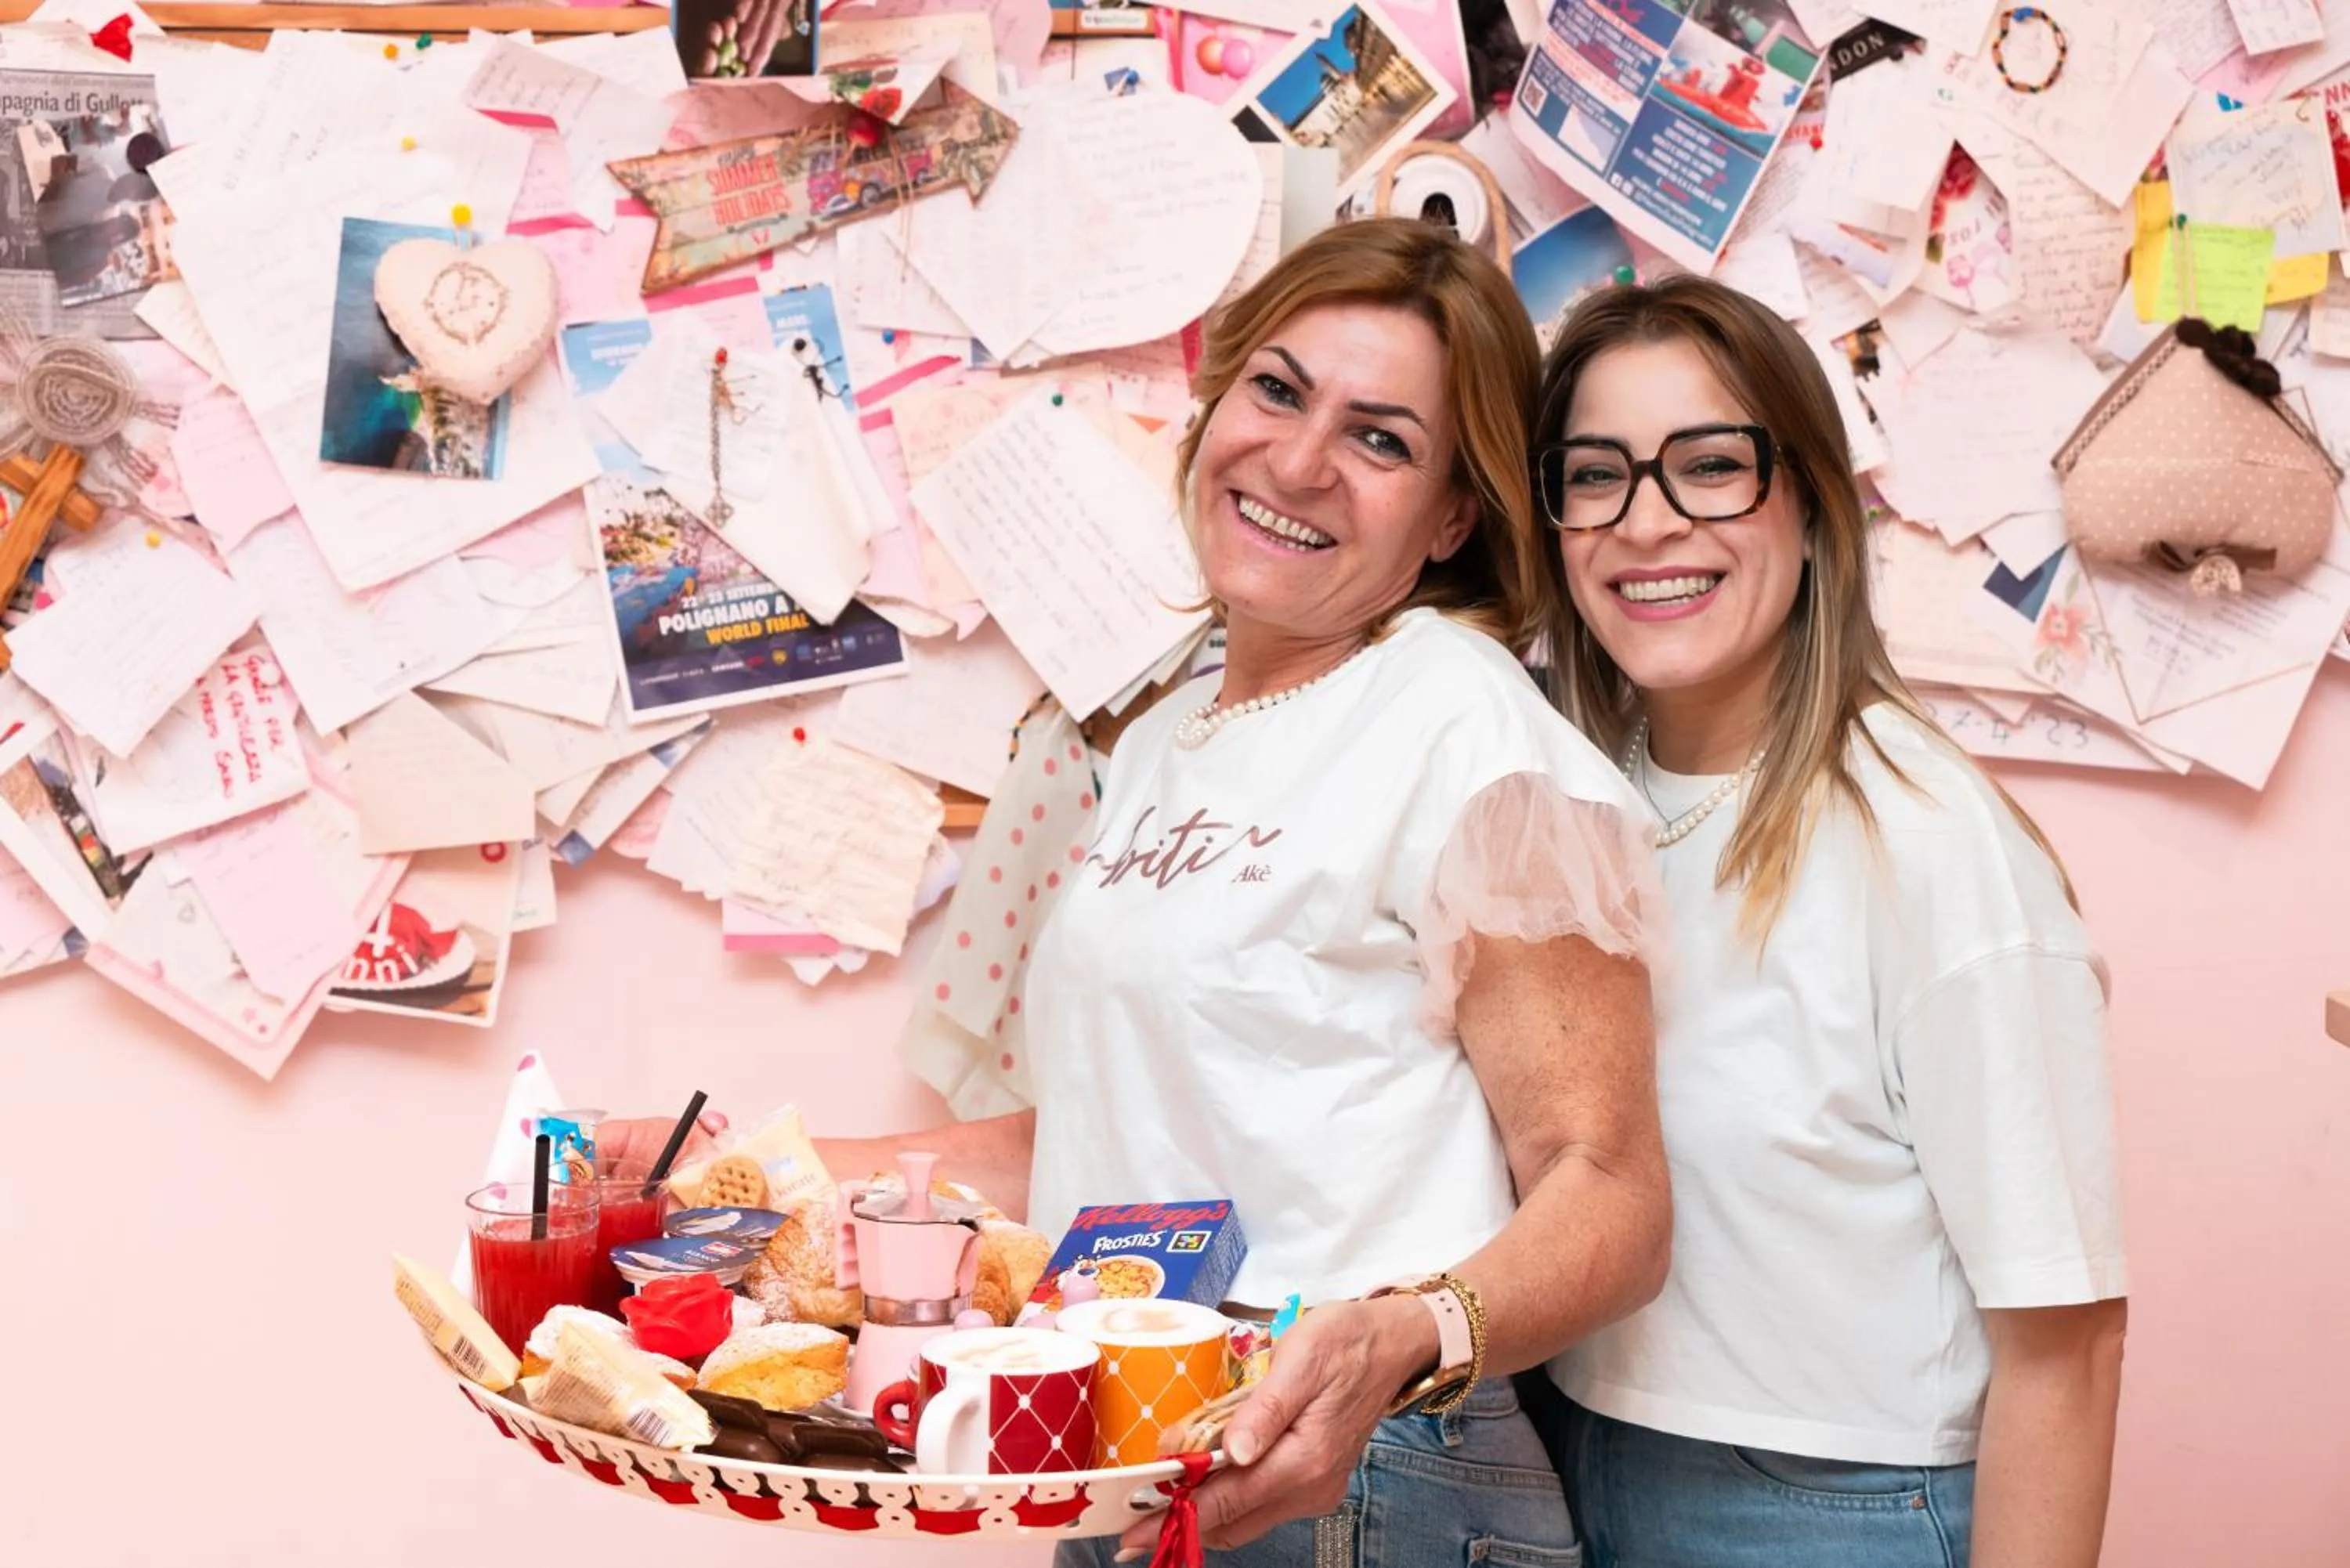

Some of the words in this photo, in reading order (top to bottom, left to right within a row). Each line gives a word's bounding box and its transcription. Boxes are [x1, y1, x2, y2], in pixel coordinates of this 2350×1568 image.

[1830, 31, 1885, 70] DON
[65, 91, 81, 112] di
[706, 151, 778, 197] SUMMER
[713, 183, 794, 227] HOLIDAYS
[658, 598, 770, 636] POLIGNANO
[774, 593, 790, 615] A
[706, 620, 762, 645] WORLD
[765, 612, 810, 634] FINAL
[1071, 1201, 1230, 1230] Kellogg's
[1092, 1230, 1169, 1254] FROSTIES
